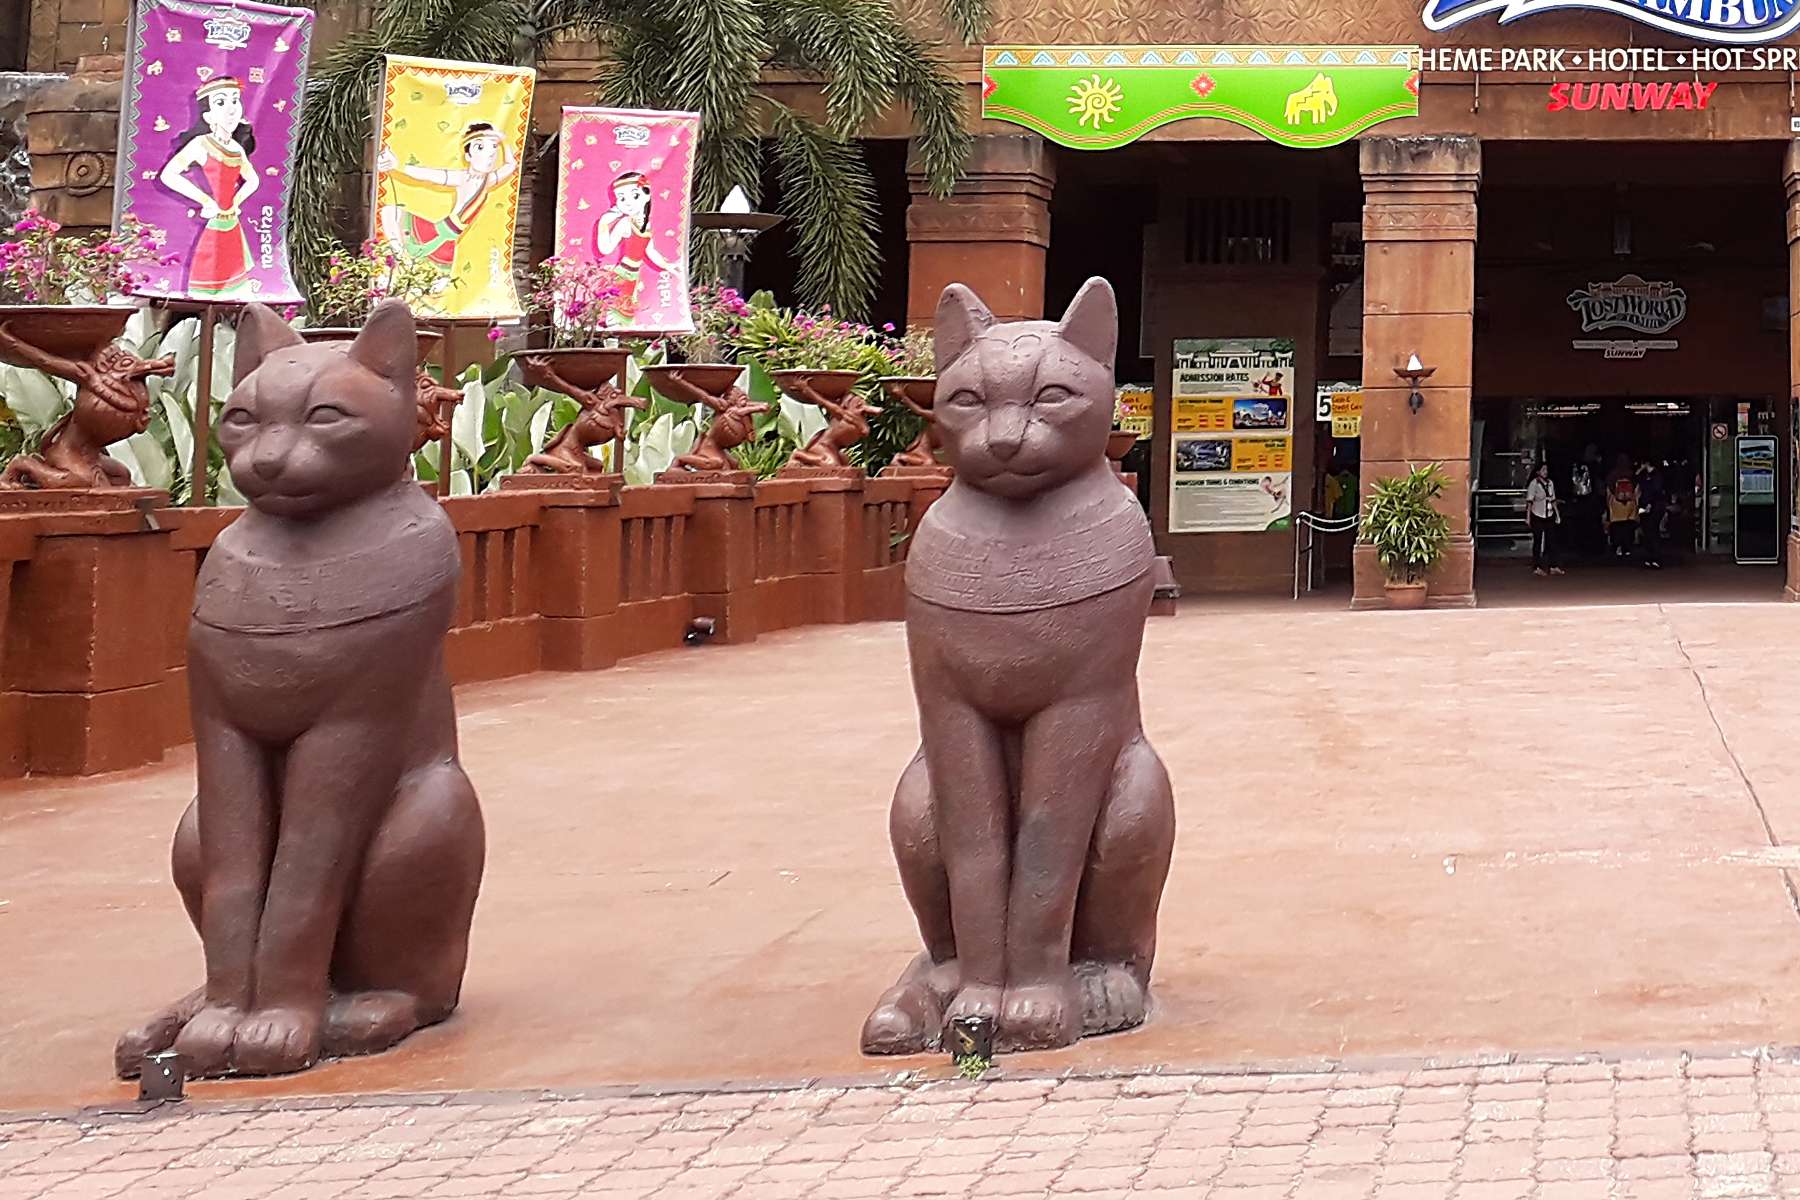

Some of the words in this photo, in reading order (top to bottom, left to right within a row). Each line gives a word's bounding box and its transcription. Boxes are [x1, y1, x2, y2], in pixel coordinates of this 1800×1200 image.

[1405, 48, 1493, 72] THEME
[1500, 48, 1566, 72] PARK
[1588, 48, 1669, 72] HOTEL
[1692, 48, 1746, 72] HOT
[1547, 81, 1718, 112] SUNWAY
[1179, 373, 1224, 382] ADMISSION
[1225, 372, 1250, 382] RATES
[1319, 395, 1332, 417] 5
